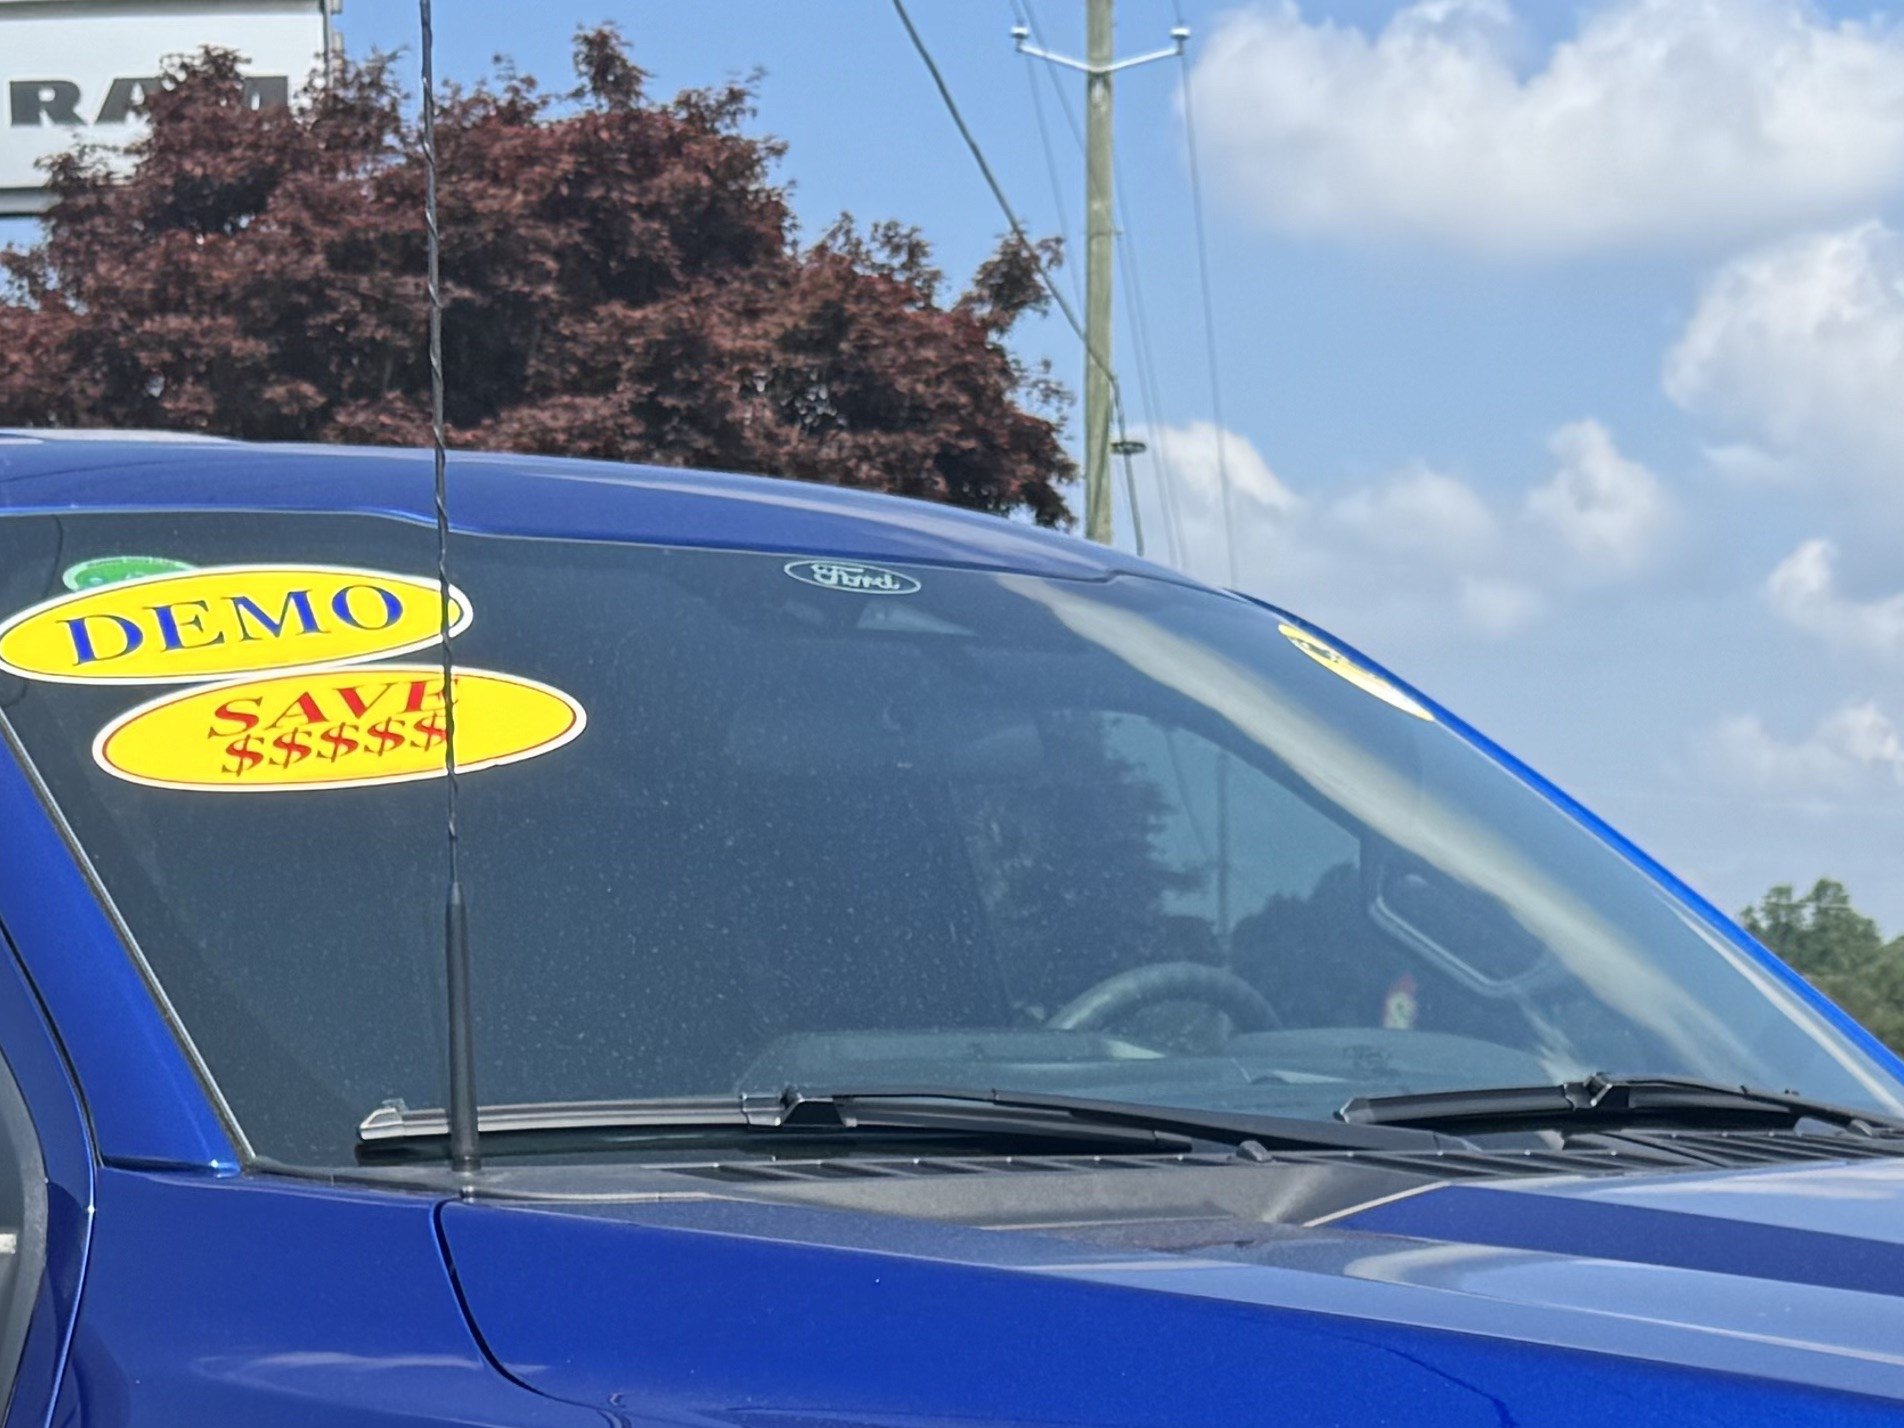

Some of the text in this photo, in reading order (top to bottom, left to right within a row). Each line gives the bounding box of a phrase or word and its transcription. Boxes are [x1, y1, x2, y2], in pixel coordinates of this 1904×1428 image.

[811, 563, 900, 589] Ford
[55, 583, 404, 667] DEMO
[207, 676, 461, 741] SAVE
[220, 707, 452, 777] $$$$$
